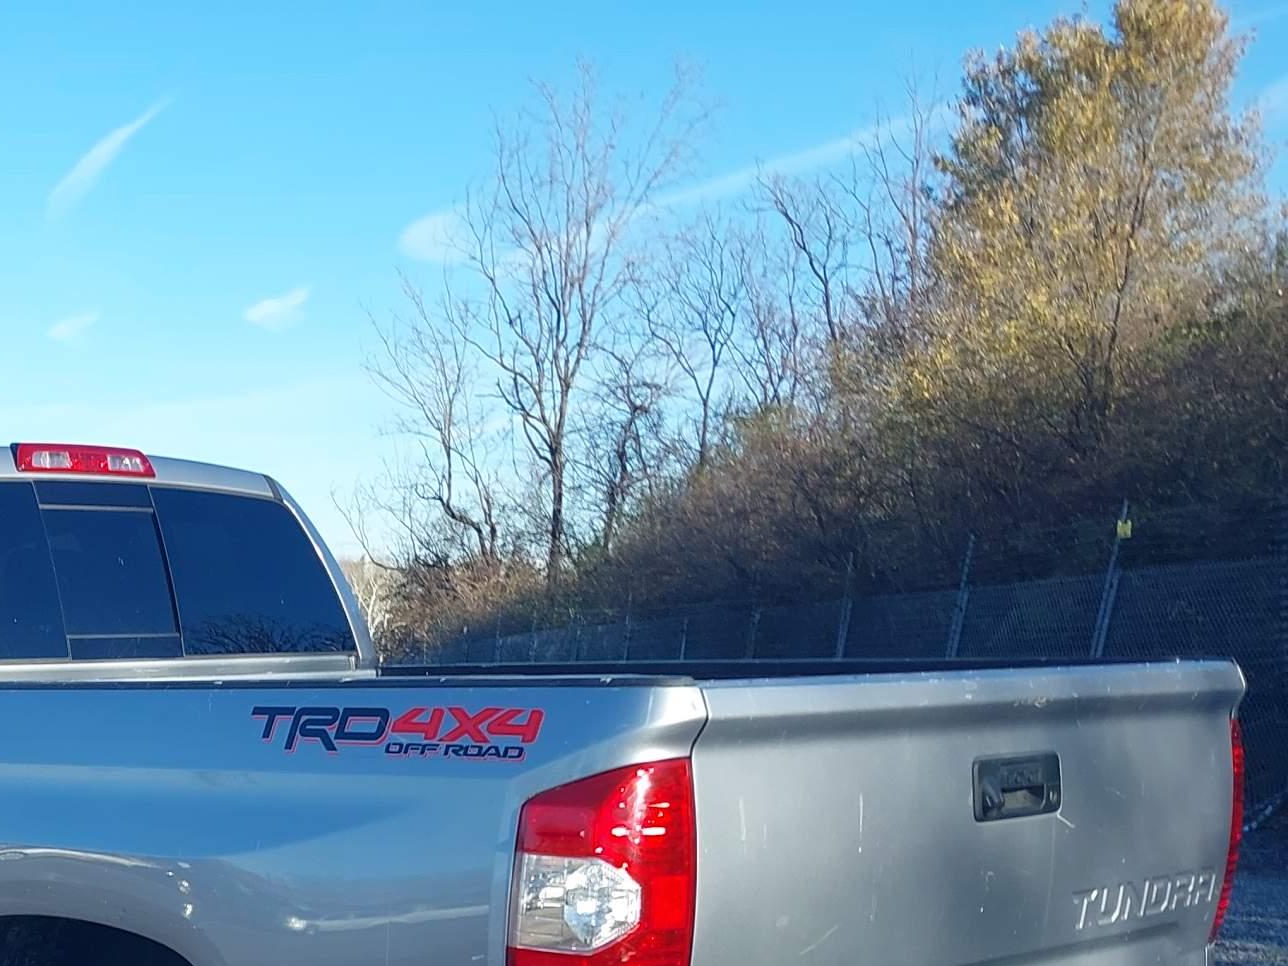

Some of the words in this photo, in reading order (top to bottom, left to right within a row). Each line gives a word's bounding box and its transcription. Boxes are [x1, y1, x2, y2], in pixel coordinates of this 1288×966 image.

[251, 706, 391, 752] TRD
[391, 706, 544, 744] 4X4
[384, 742, 441, 757] OFF
[443, 743, 526, 762] ROAD
[1073, 868, 1219, 930] TUNDRA
